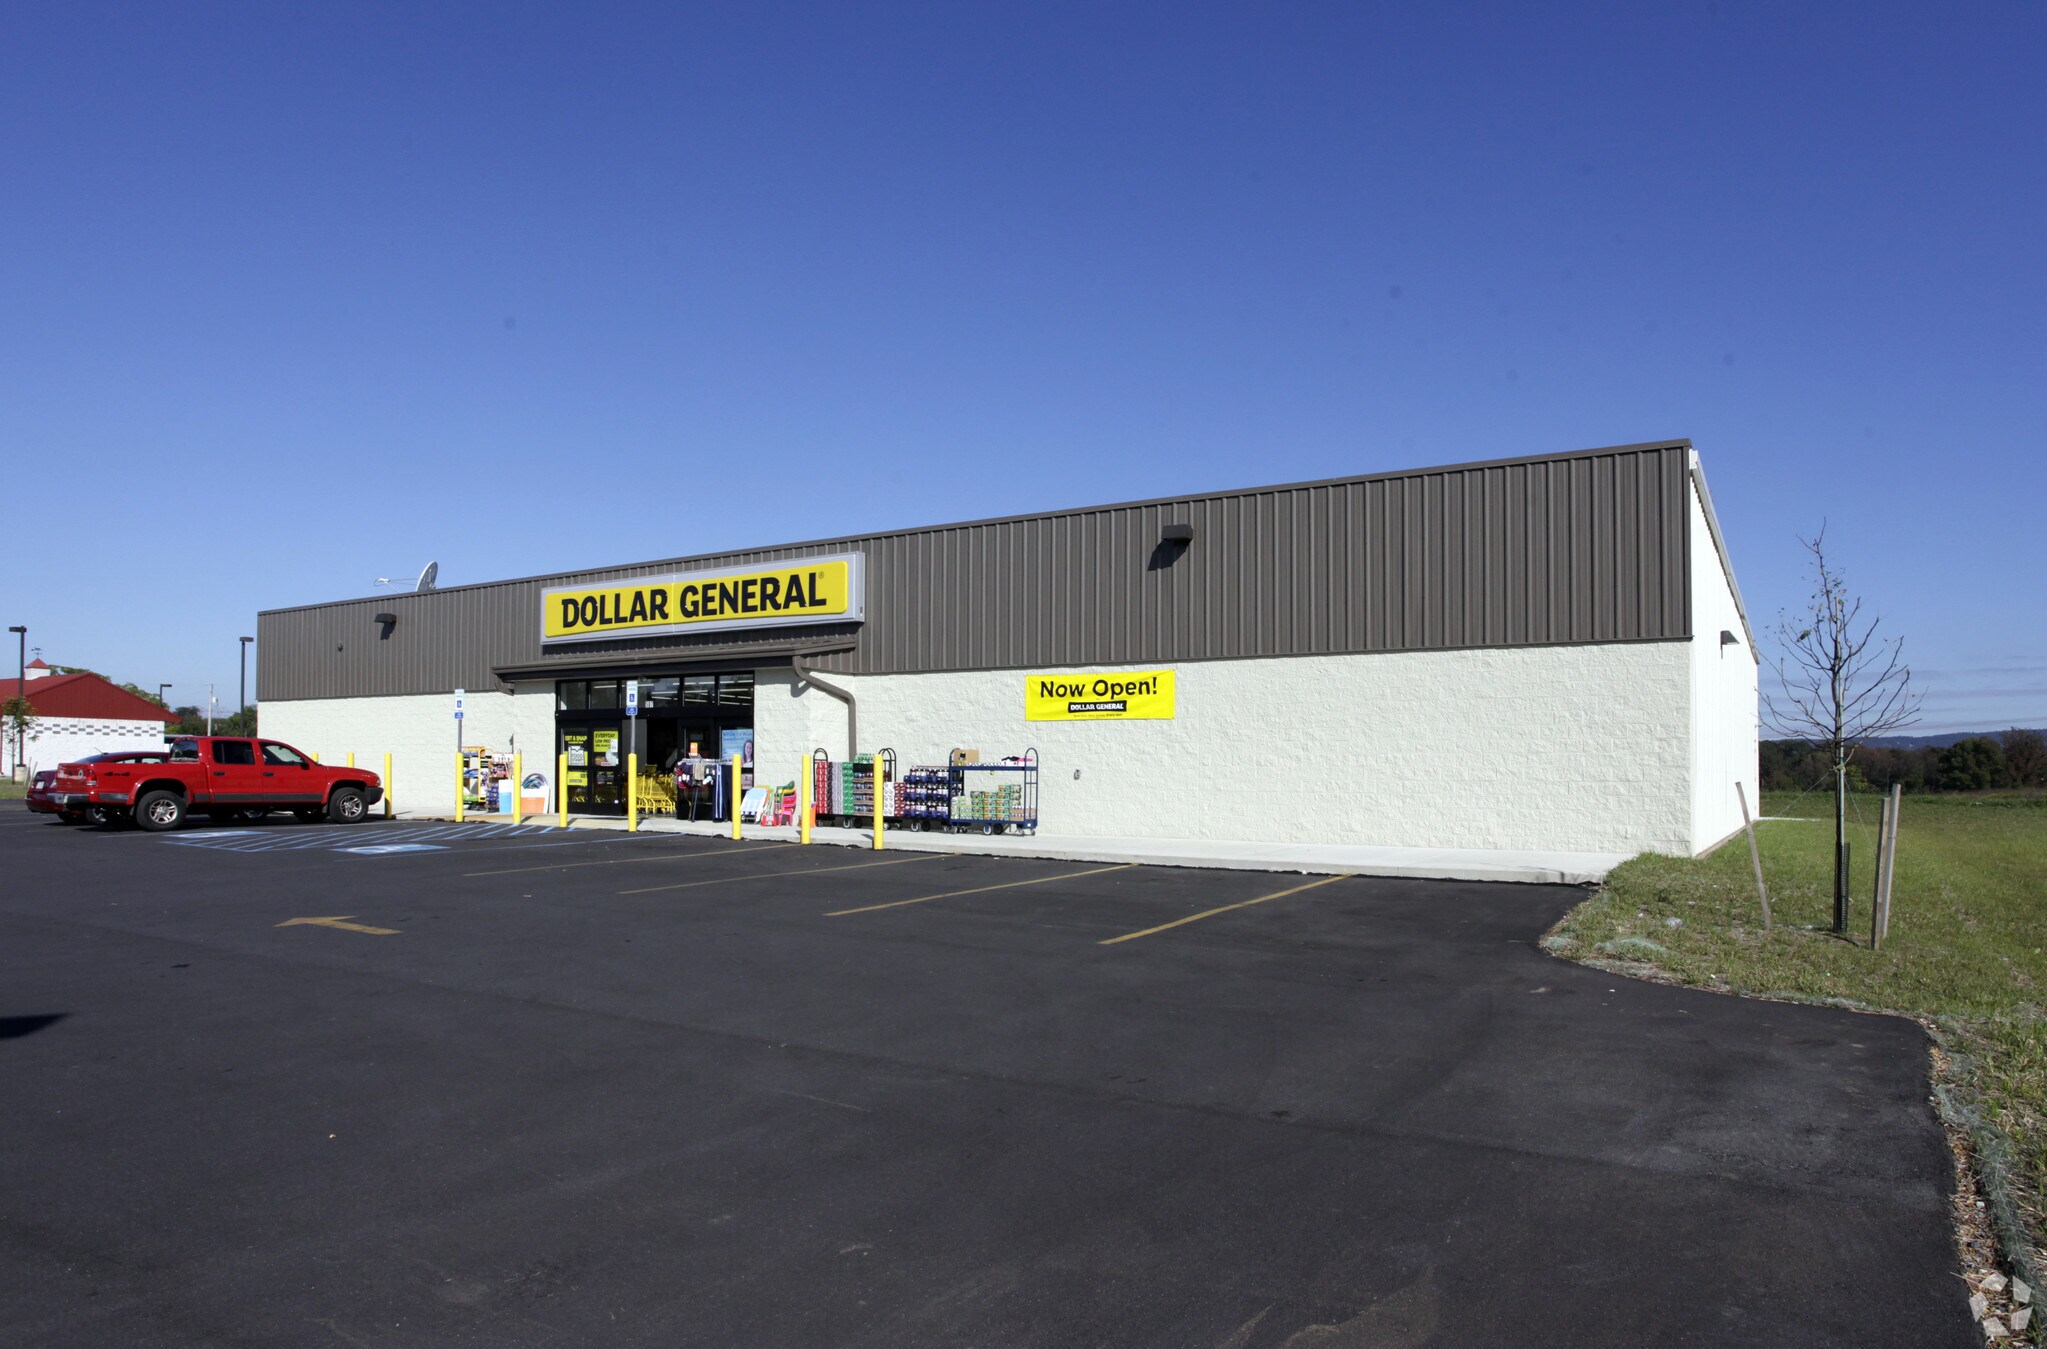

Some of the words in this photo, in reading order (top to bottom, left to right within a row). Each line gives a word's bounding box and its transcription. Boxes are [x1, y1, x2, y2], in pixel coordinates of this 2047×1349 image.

[561, 588, 668, 628] DOLLAR
[679, 572, 827, 618] GENERAL
[1040, 681, 1085, 698] Now
[1092, 677, 1157, 699] Open!
